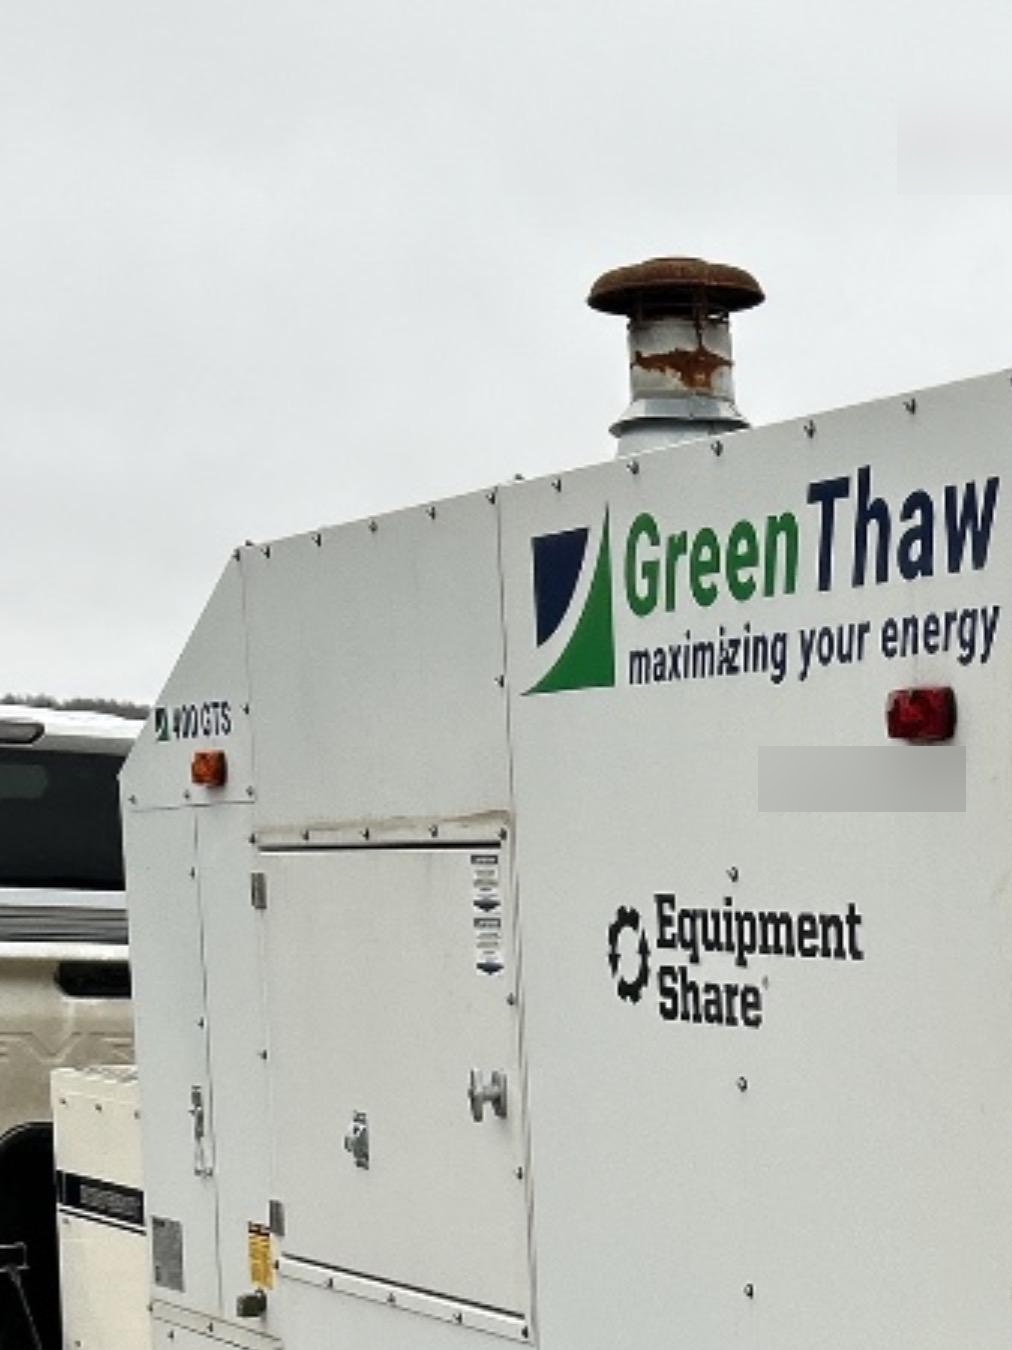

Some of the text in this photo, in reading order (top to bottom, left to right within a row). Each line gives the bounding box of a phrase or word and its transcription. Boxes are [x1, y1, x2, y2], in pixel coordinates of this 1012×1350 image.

[628, 605, 1001, 685] maximizing your energy
[201, 701, 231, 735] GTS
[654, 893, 865, 968] Equipment
[658, 965, 763, 1029] Share
